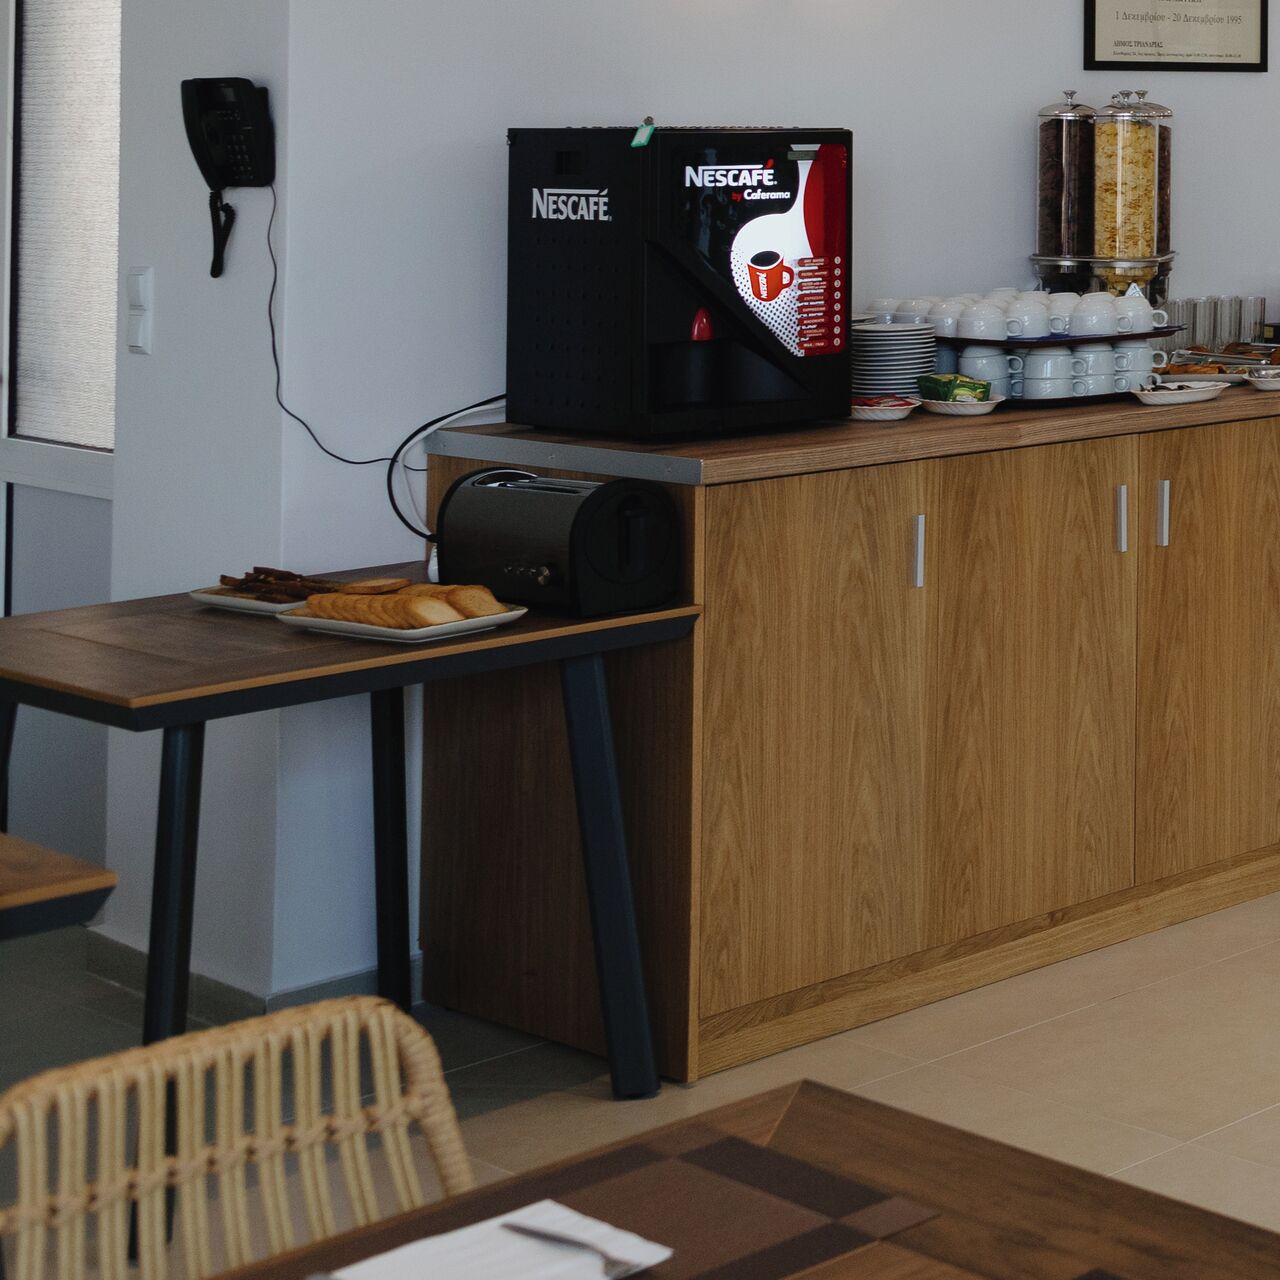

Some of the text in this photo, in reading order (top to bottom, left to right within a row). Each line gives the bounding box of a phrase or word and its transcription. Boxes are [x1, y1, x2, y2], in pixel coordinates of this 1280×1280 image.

[685, 159, 774, 187] NESCAFÉ
[532, 188, 608, 221] NESCAFÉ
[744, 189, 790, 200] Caferama
